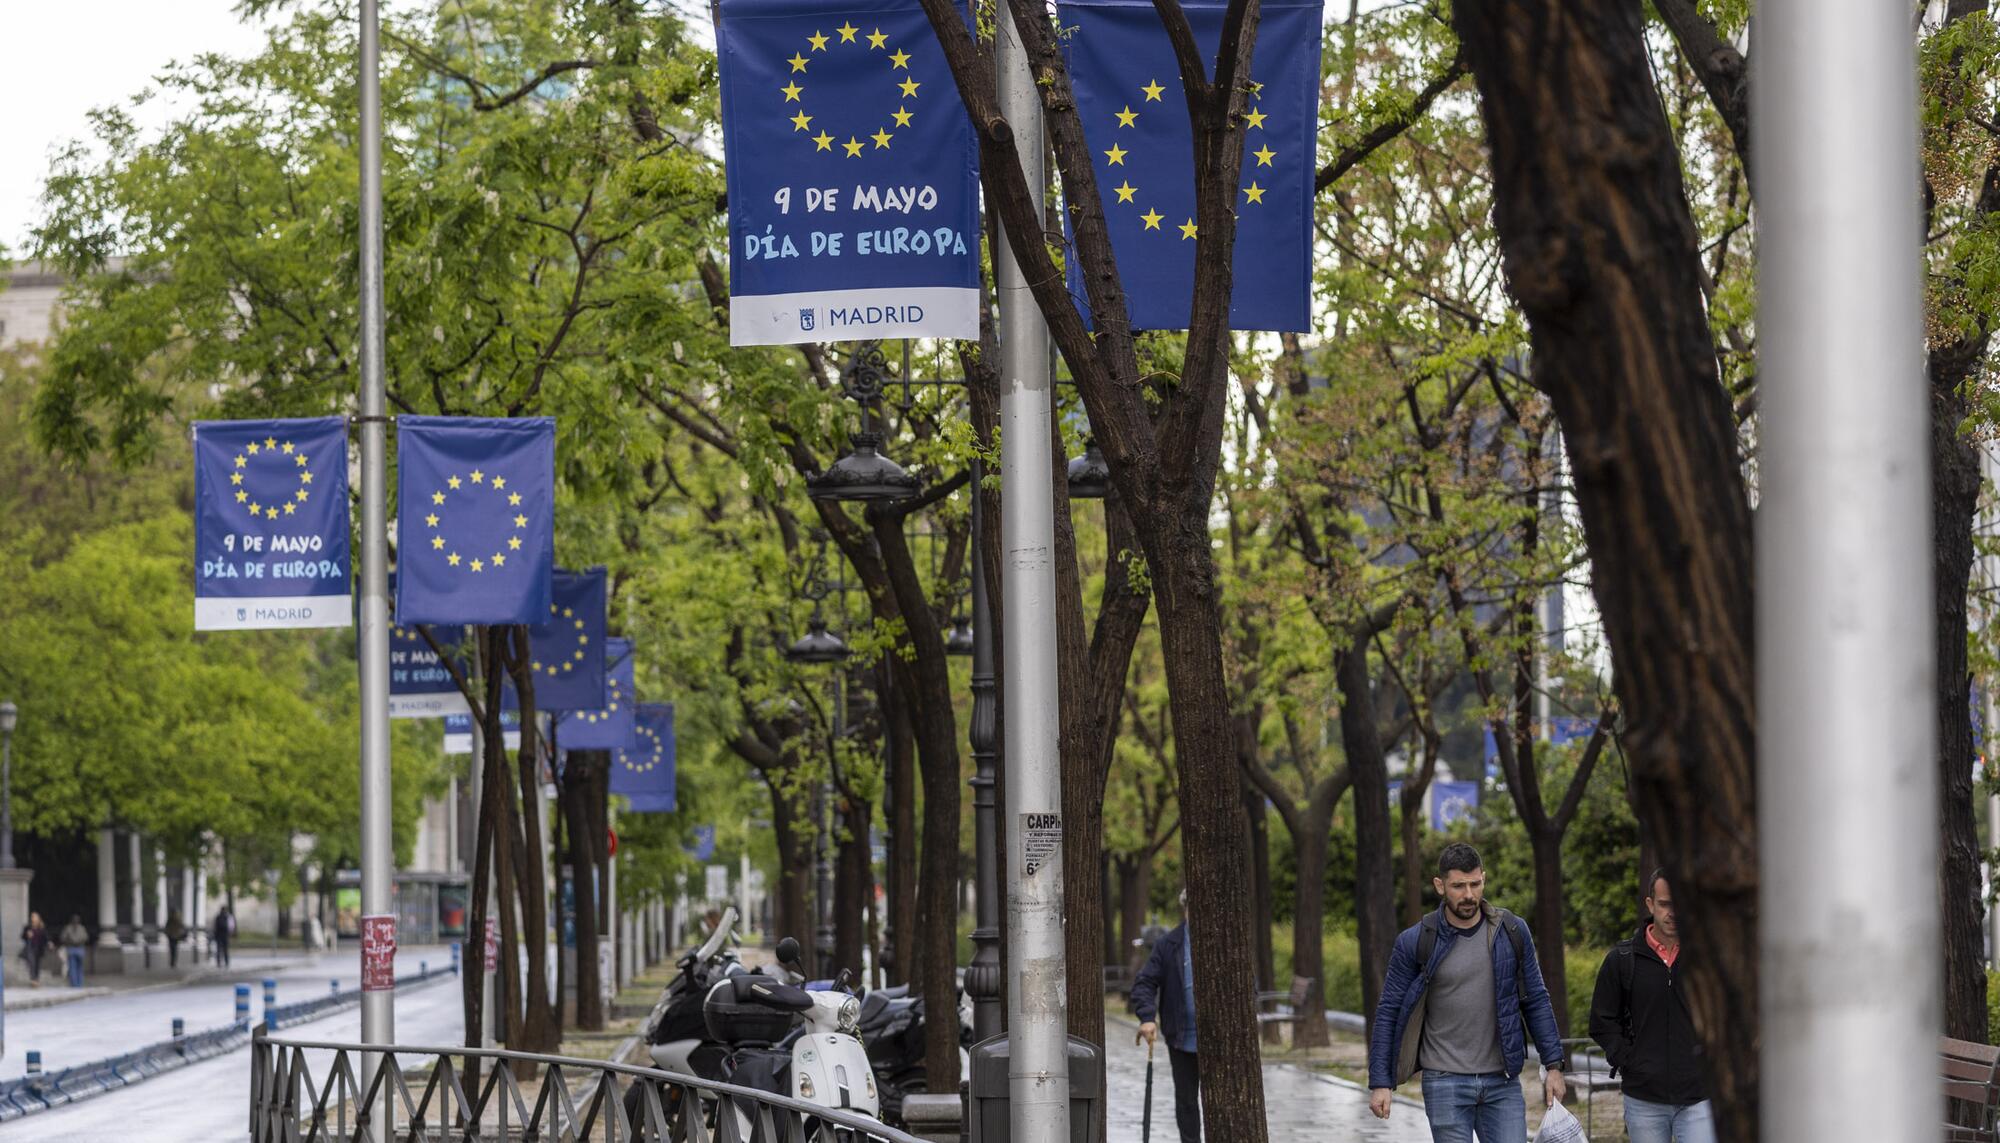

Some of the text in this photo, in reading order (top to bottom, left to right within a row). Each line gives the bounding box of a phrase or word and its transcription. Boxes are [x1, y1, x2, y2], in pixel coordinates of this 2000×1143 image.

[774, 185, 938, 215] 9 DE MAYO
[745, 224, 967, 260] DÍA DE EUROPA
[830, 306, 924, 327] MADRID
[224, 534, 323, 554] 9 DE MAYO
[204, 555, 342, 579] DÍA DE EUROPA
[255, 607, 313, 620] MADRID
[391, 650, 439, 665] DE MAY
[393, 667, 452, 683] DE EUROP
